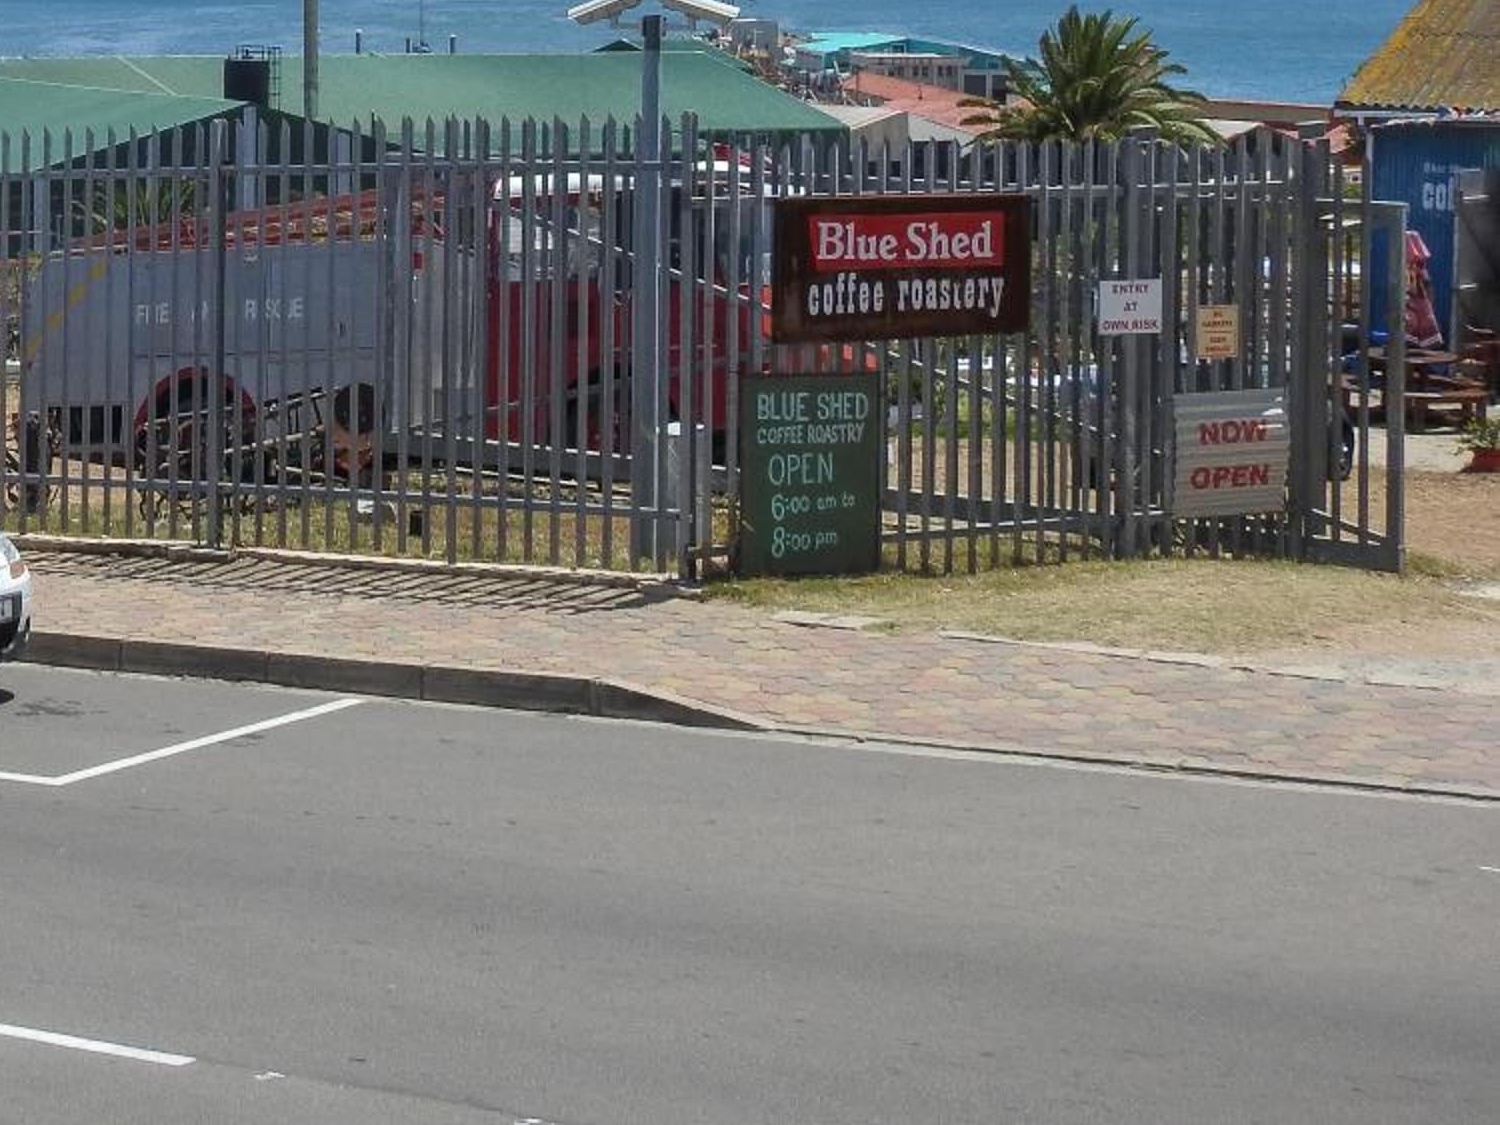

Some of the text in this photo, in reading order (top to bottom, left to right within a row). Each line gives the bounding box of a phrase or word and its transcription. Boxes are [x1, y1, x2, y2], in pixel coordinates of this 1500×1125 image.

[816, 220, 994, 261] Blue Shed
[808, 273, 1005, 317] coffee roastery
[1112, 283, 1149, 294] ENTRY
[1123, 300, 1138, 312] AT
[1102, 319, 1129, 331] OWN
[757, 392, 869, 422] BLUE SHED
[757, 423, 865, 444] COFFEE ROASTRY
[1199, 419, 1268, 445] NOW
[768, 452, 834, 486] OPEN
[1190, 463, 1270, 490] OPEN
[771, 491, 856, 521] 6:00 am to
[771, 526, 837, 558] 8:00 pm
